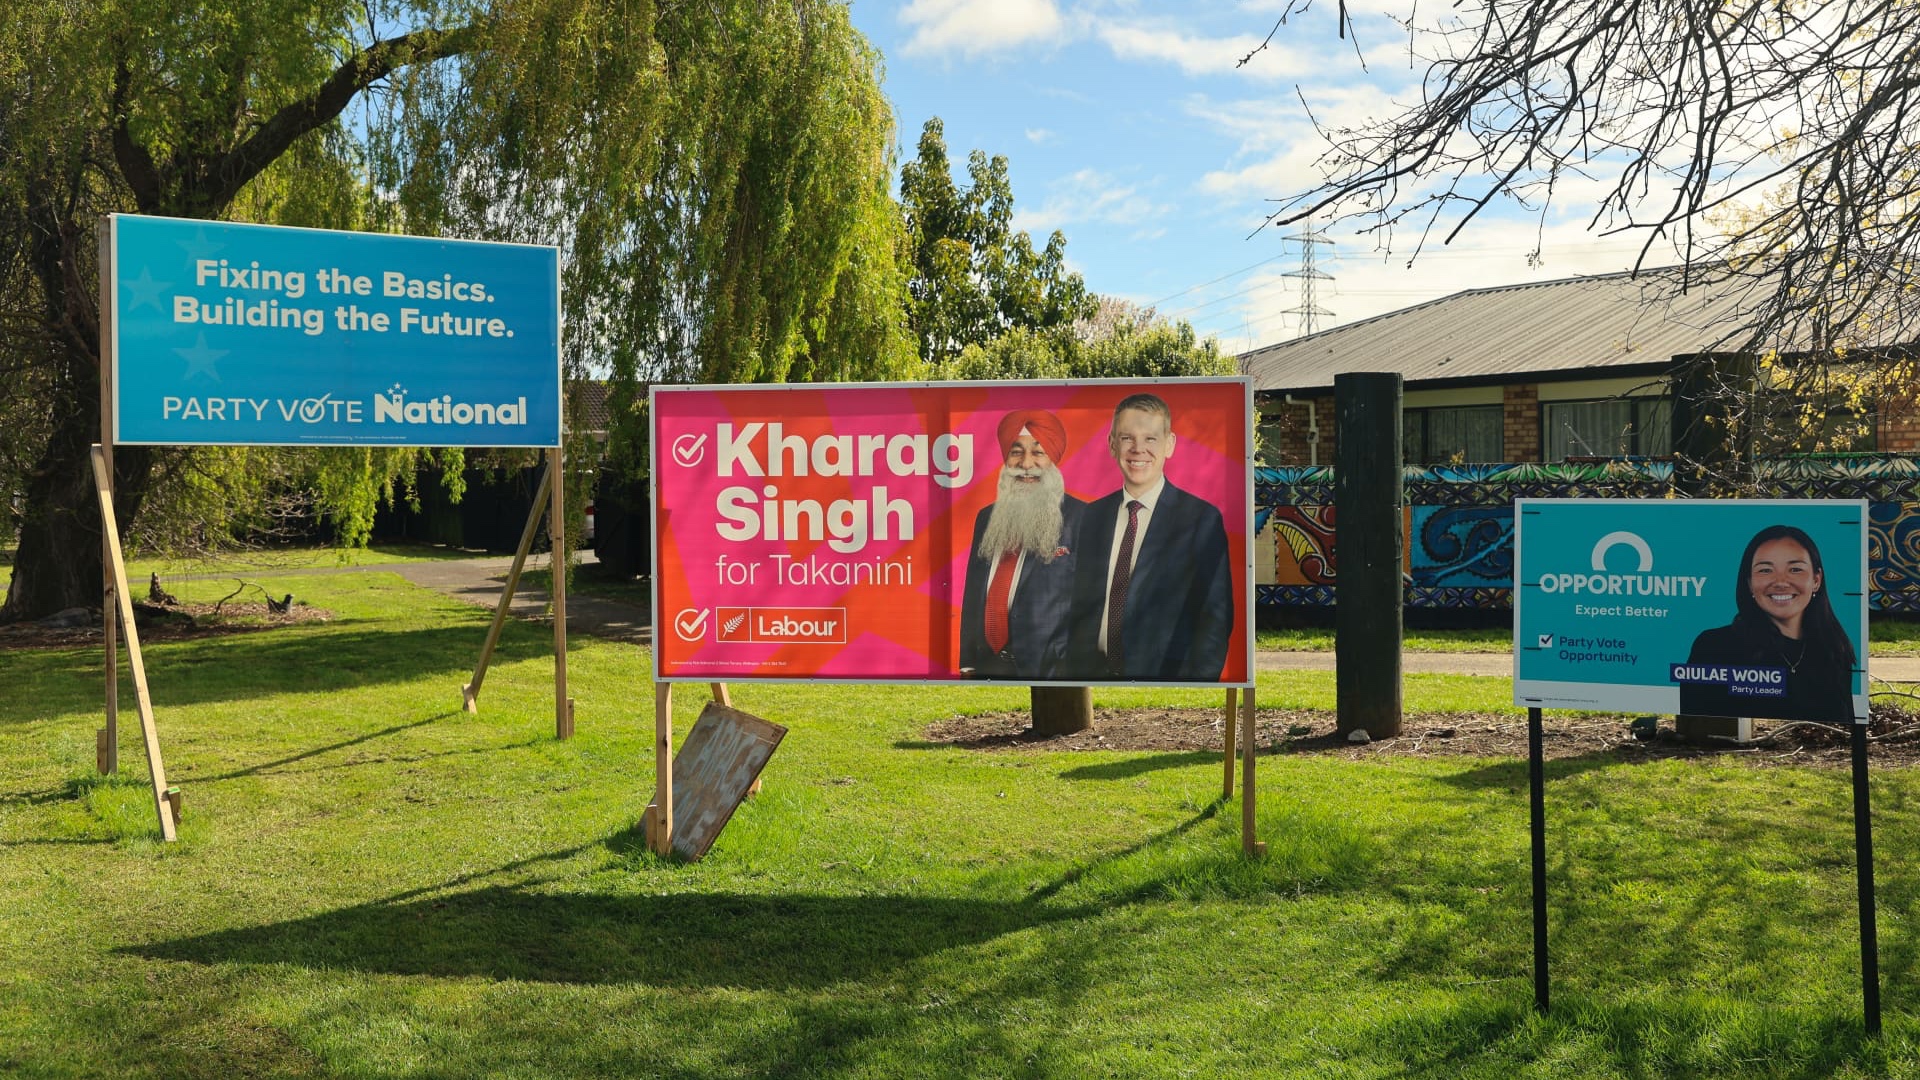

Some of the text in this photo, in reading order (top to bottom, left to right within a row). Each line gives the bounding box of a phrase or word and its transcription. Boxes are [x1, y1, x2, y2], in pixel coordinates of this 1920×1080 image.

[196, 258, 495, 303] Fixing the Basics.
[173, 295, 515, 338] Building the Future.
[163, 393, 527, 425] PARTY VOTE National
[716, 422, 974, 489] Kharag
[715, 484, 914, 554] Singh
[715, 554, 912, 586] for Takanini
[1539, 573, 1707, 597] OPPORTUNITY
[1575, 604, 1669, 618] Expect Better
[758, 614, 838, 638] Labour
[1559, 636, 1627, 650] Party Vote
[1558, 650, 1639, 665] Opportunity
[1674, 666, 1782, 684] QIULAE WONG
[1731, 685, 1783, 696] Party Leader
